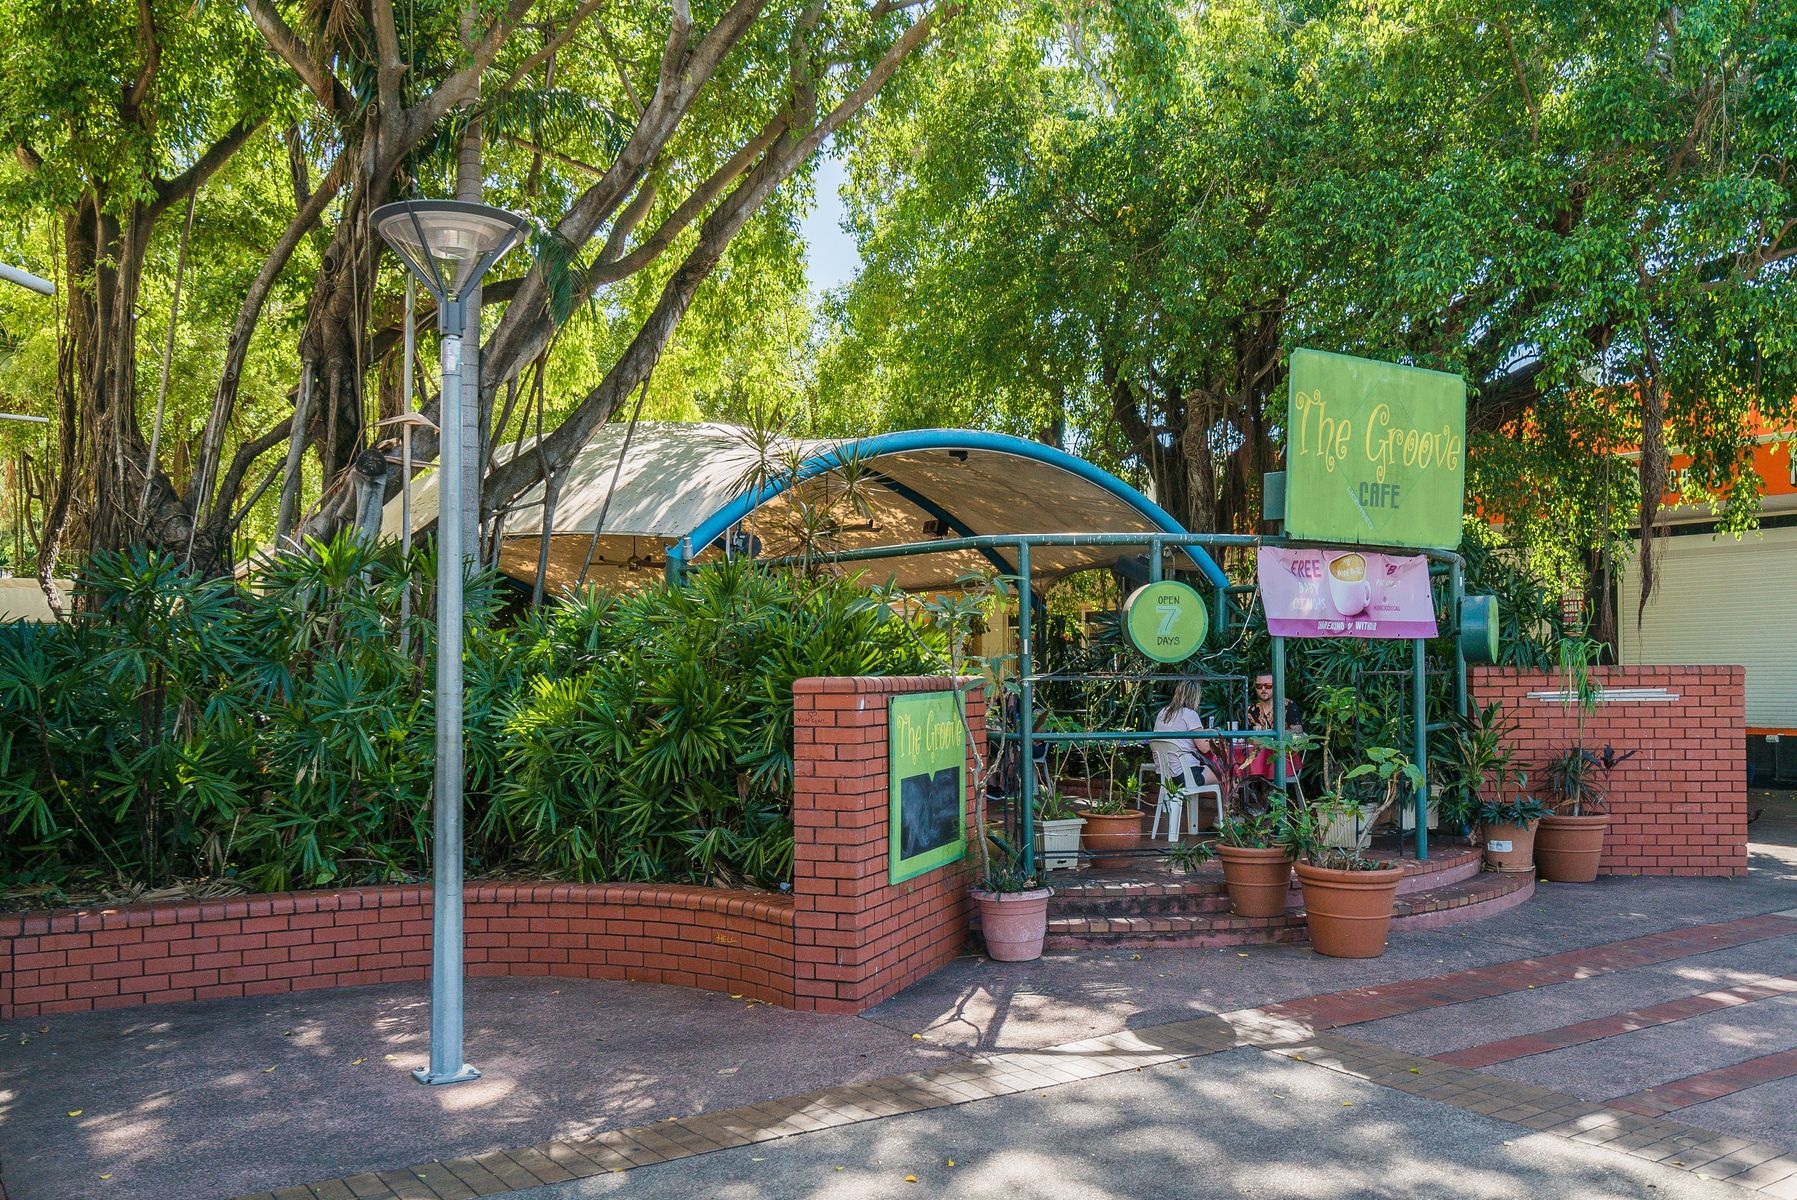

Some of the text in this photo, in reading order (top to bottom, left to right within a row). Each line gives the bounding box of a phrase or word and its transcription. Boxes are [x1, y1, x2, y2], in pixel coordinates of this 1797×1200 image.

[1295, 388, 1461, 483] The Groove
[1359, 481, 1400, 509] CAFE
[1291, 559, 1322, 578] FREE
[1157, 595, 1180, 605] OPEN
[1155, 604, 1183, 636] 7
[1157, 636, 1181, 646] DAYS
[897, 710, 962, 766] The Groove
